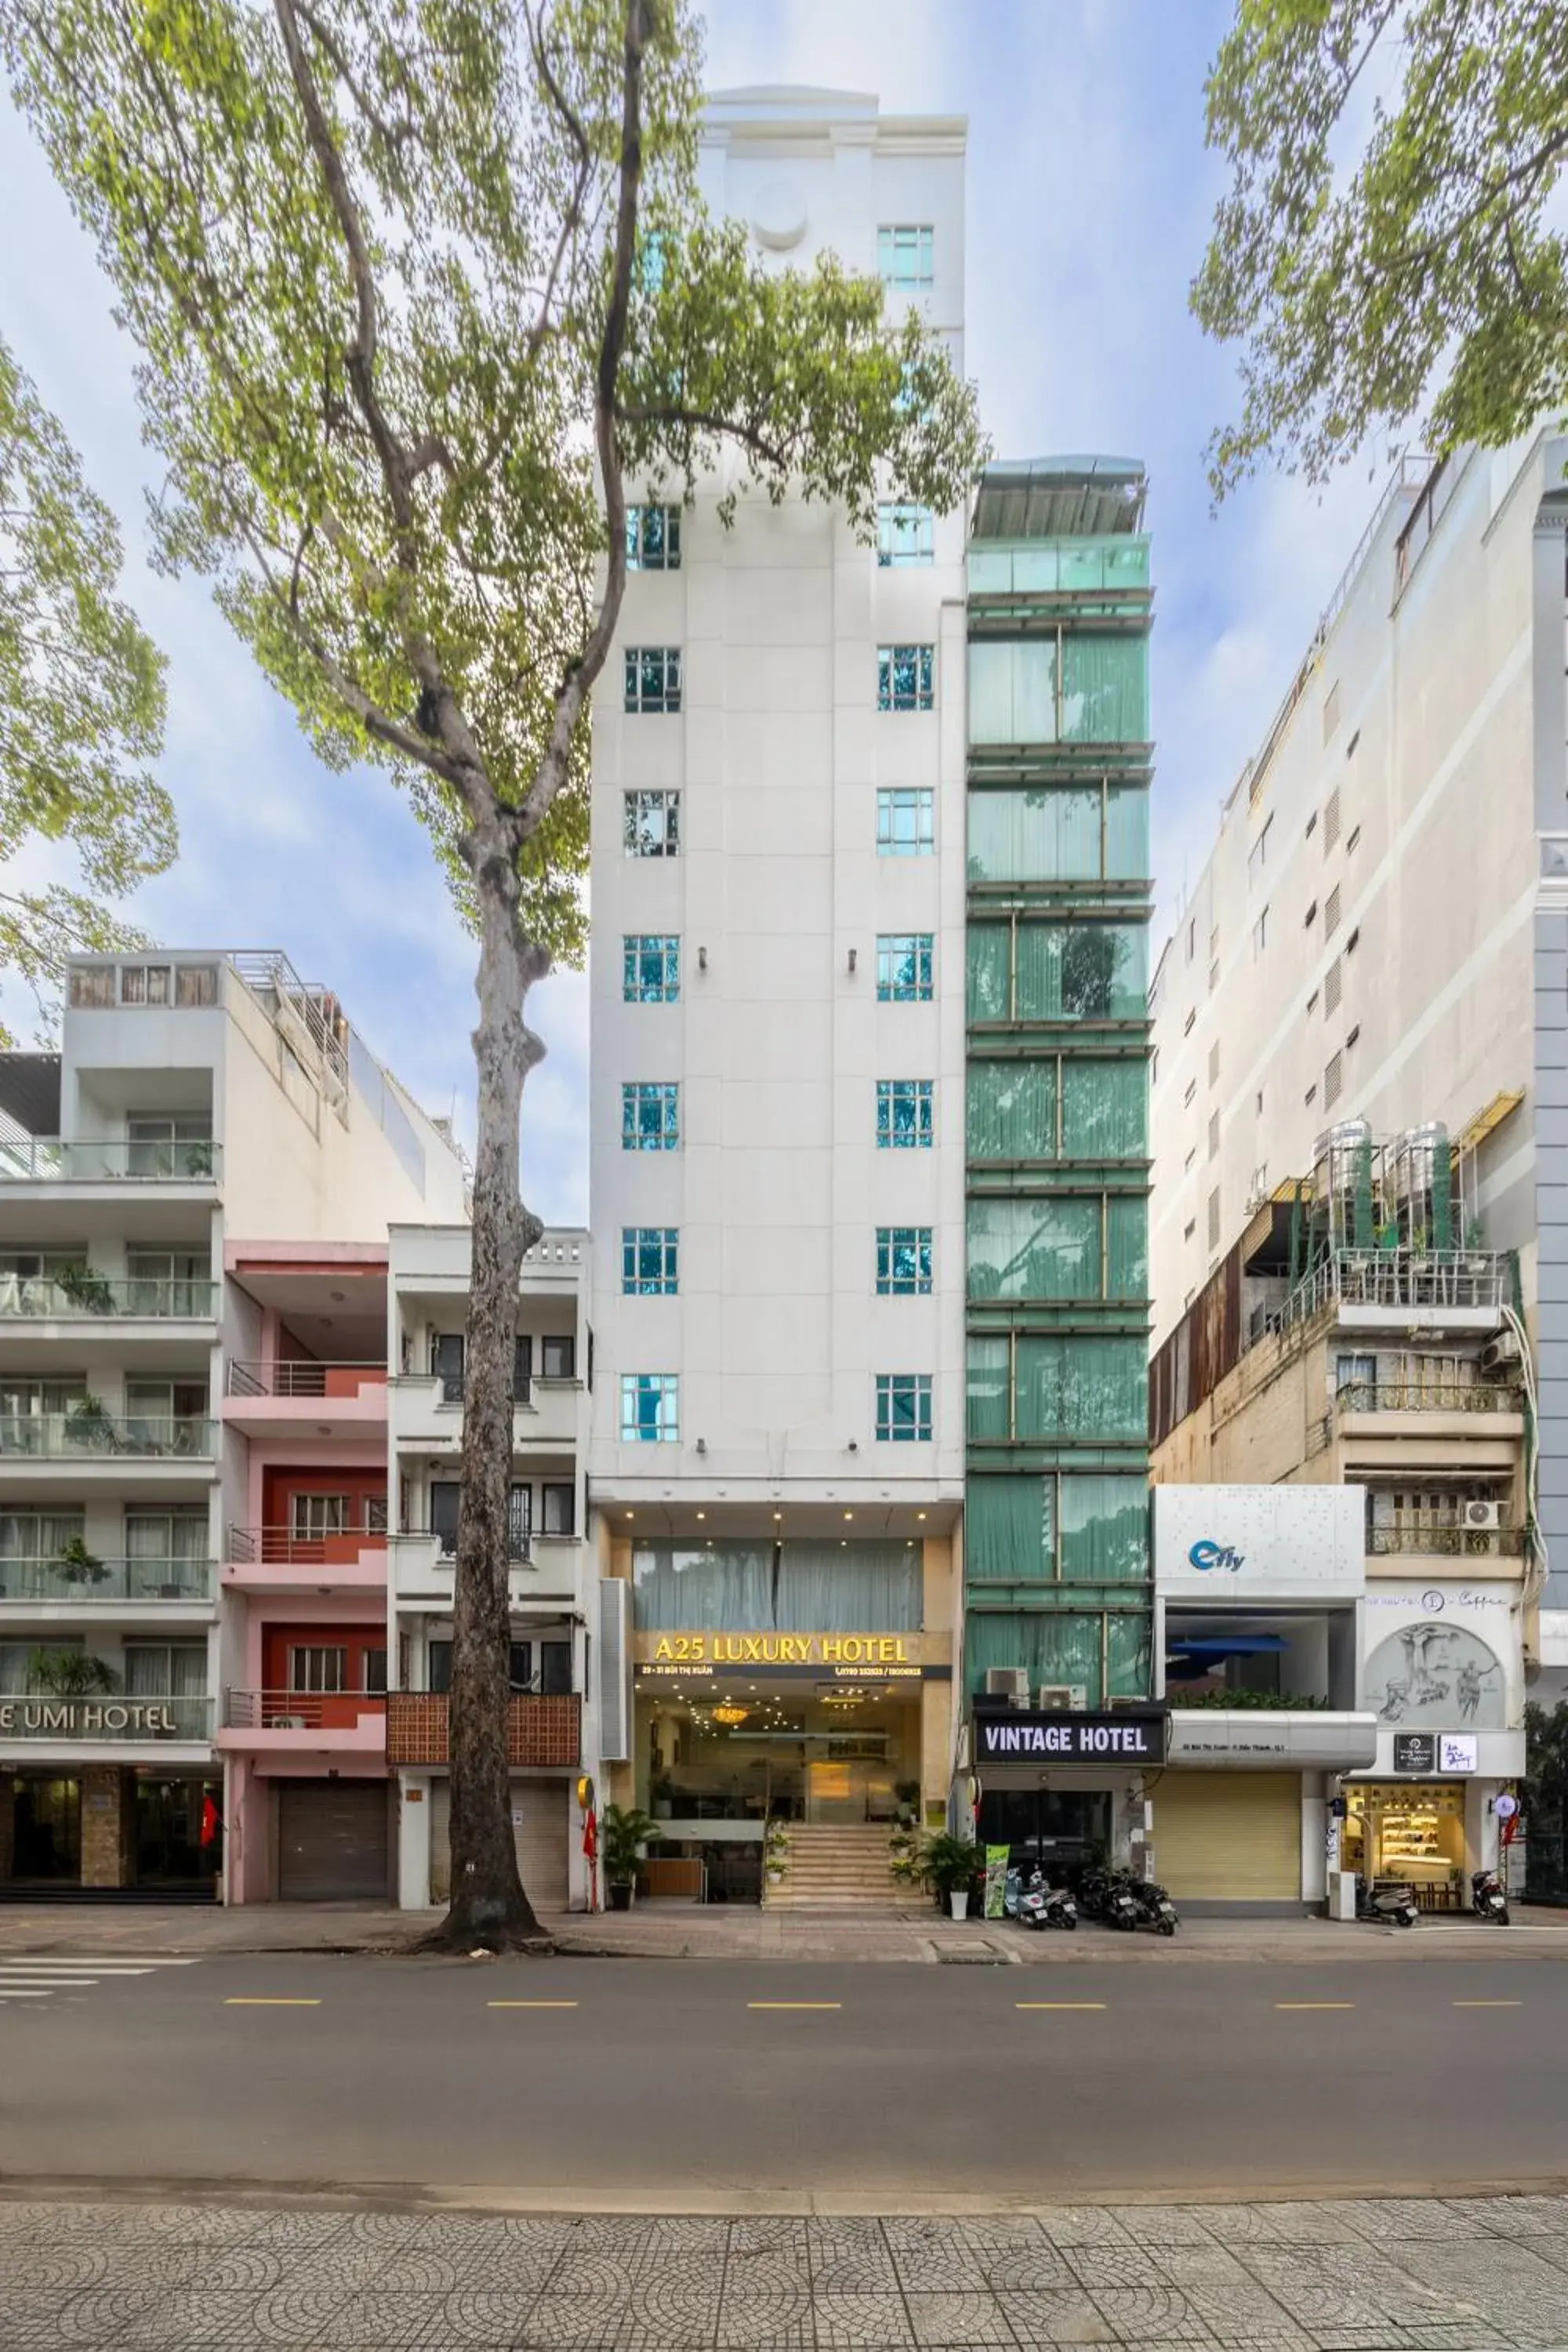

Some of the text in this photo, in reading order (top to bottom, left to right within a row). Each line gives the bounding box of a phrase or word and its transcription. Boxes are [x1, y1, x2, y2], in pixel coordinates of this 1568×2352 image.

[655, 1637, 909, 1661] A25 LUXURY HOTEL
[24, 1705, 74, 1729] UMI
[84, 1705, 176, 1730] HOTEL
[985, 1726, 1147, 1751] VINTAGE HOTEL
